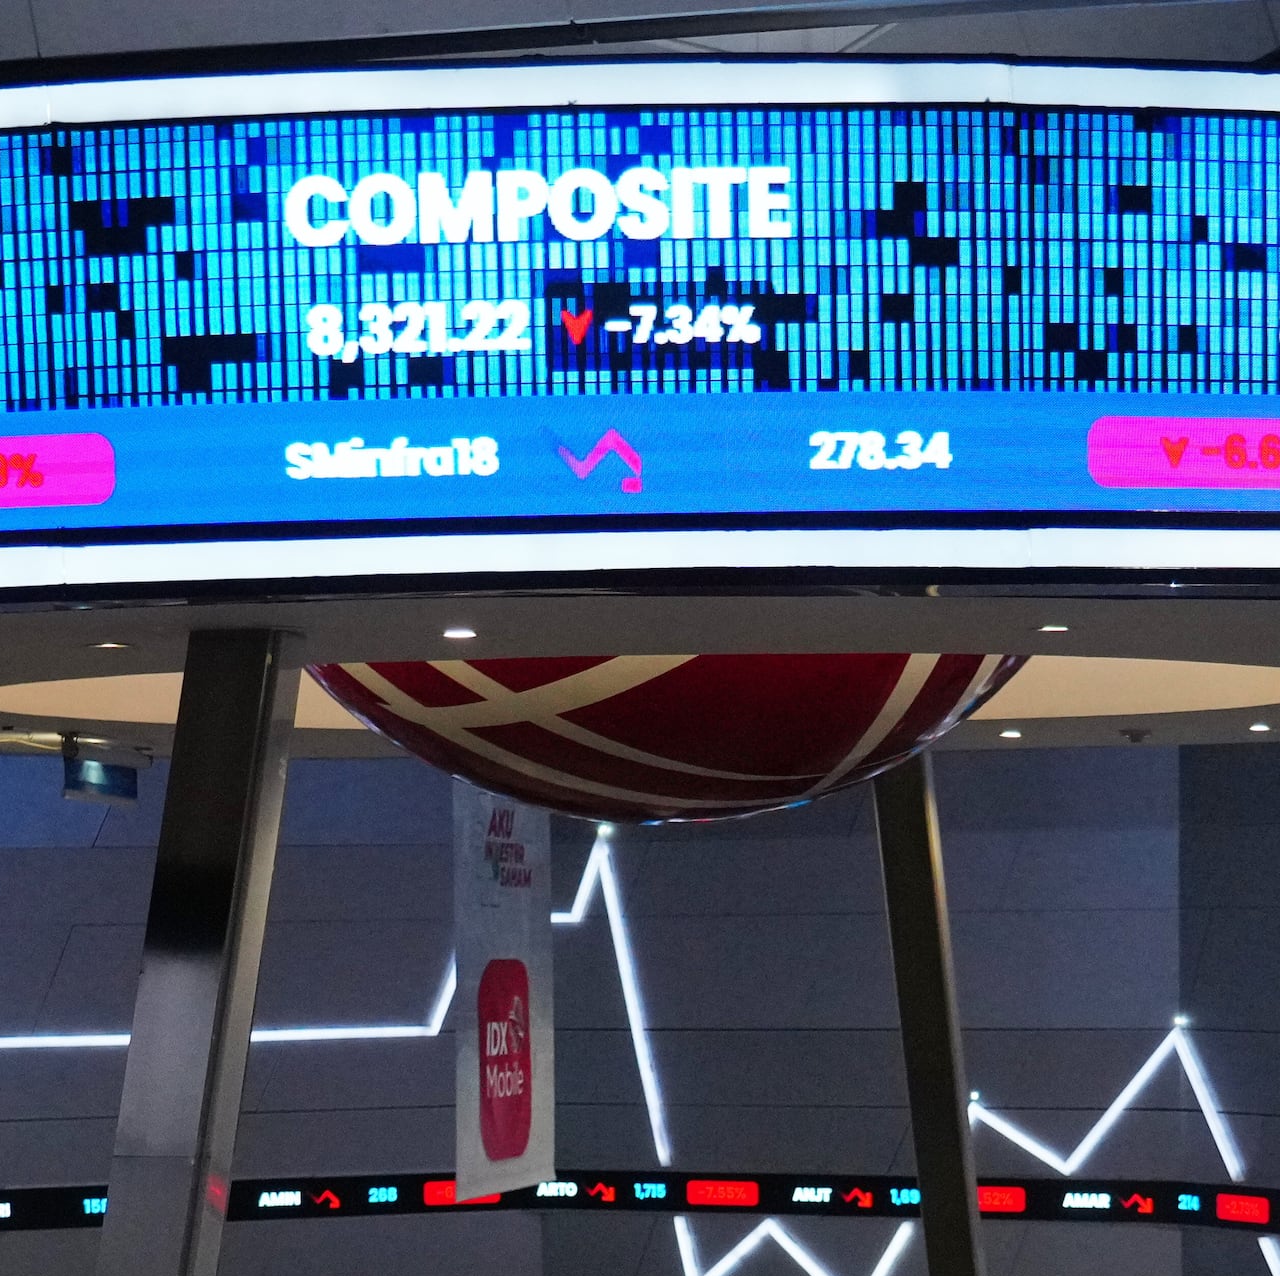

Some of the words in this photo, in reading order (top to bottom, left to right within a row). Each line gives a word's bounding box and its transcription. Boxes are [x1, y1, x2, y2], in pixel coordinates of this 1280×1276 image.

[284, 166, 793, 247] COMPOSITE
[306, 300, 532, 362] 8,321.22
[604, 305, 761, 346] -7.34%
[809, 431, 951, 469] 278.34
[486, 1021, 508, 1058] IDX
[486, 1065, 524, 1098] Mobile
[258, 1191, 302, 1207] AMIN
[537, 1182, 578, 1197] ARTO
[698, 1186, 746, 1201] -7.55%
[792, 1187, 832, 1203] ANJT
[890, 1188, 920, 1206] 1,69
[979, 1191, 1014, 1206] .52%
[1062, 1193, 1111, 1209] AMAR
